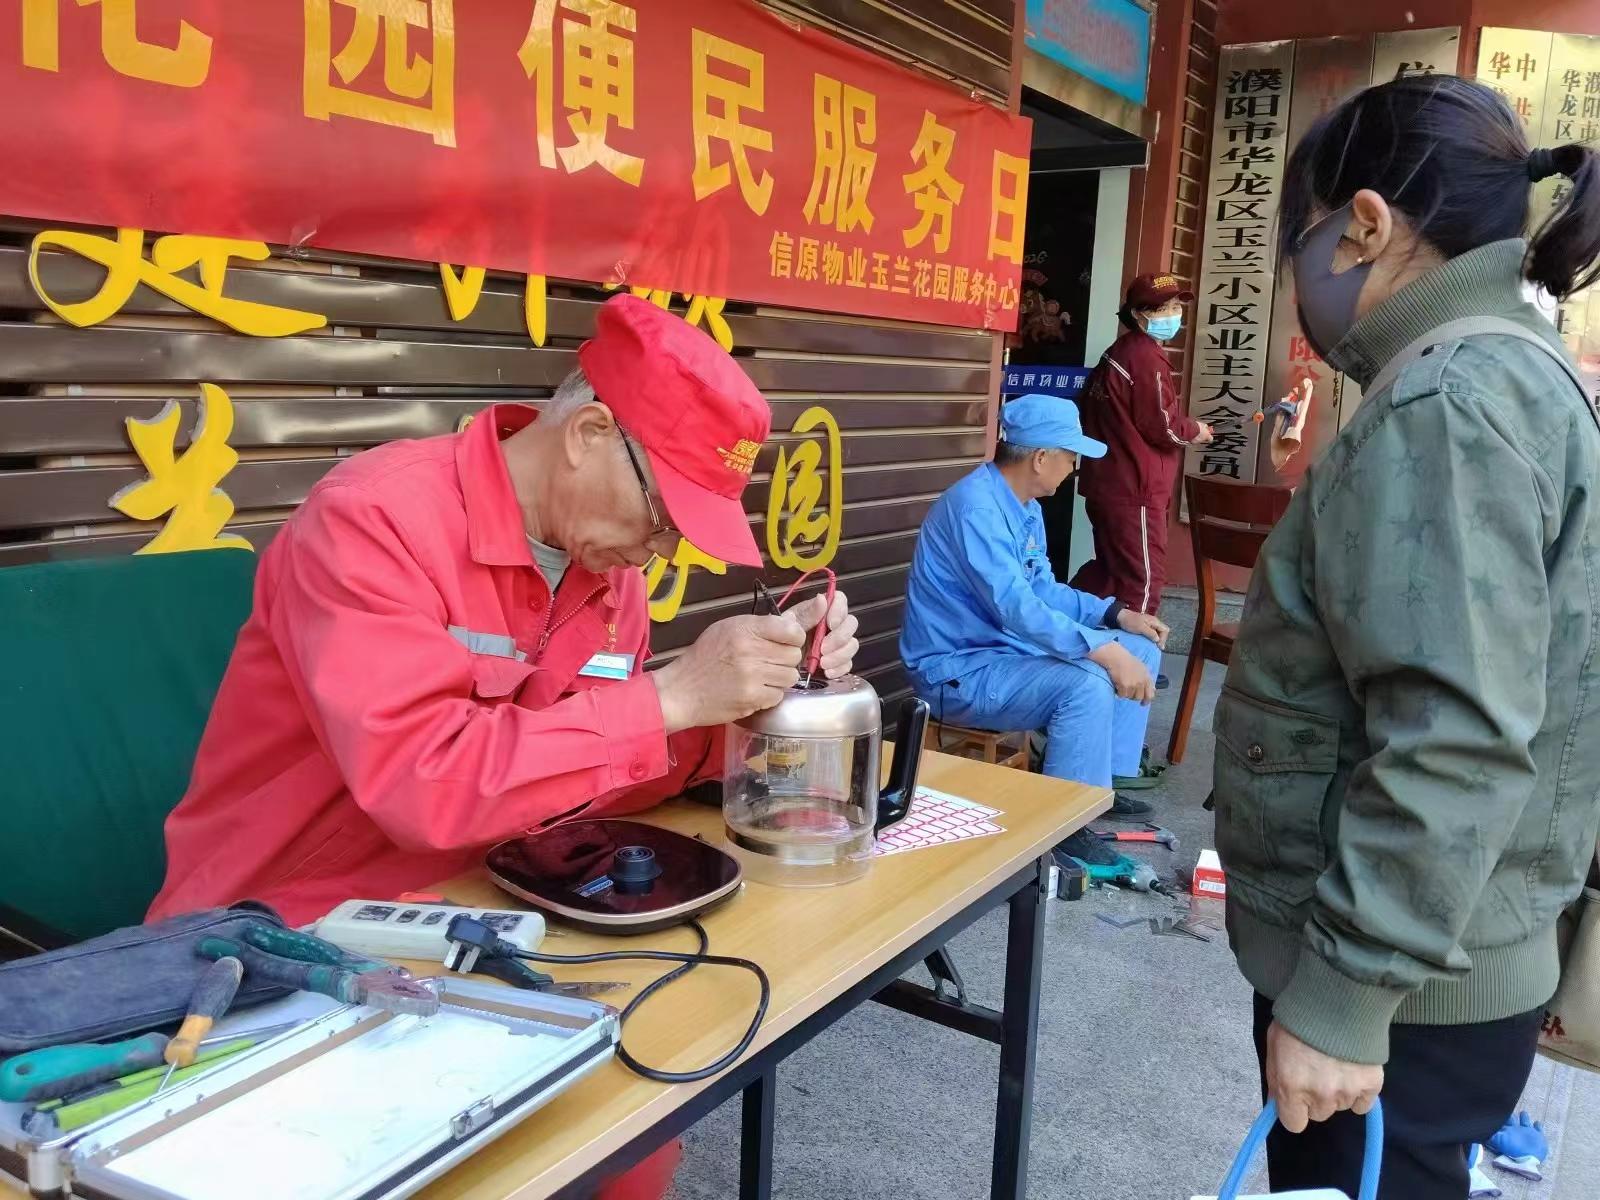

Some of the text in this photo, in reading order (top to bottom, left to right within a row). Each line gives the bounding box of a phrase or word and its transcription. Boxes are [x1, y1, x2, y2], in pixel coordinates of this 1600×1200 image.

[768, 230, 1020, 311] 信原物业玉兰花园服务中心
[1007, 373, 1087, 390] 信原物业集
